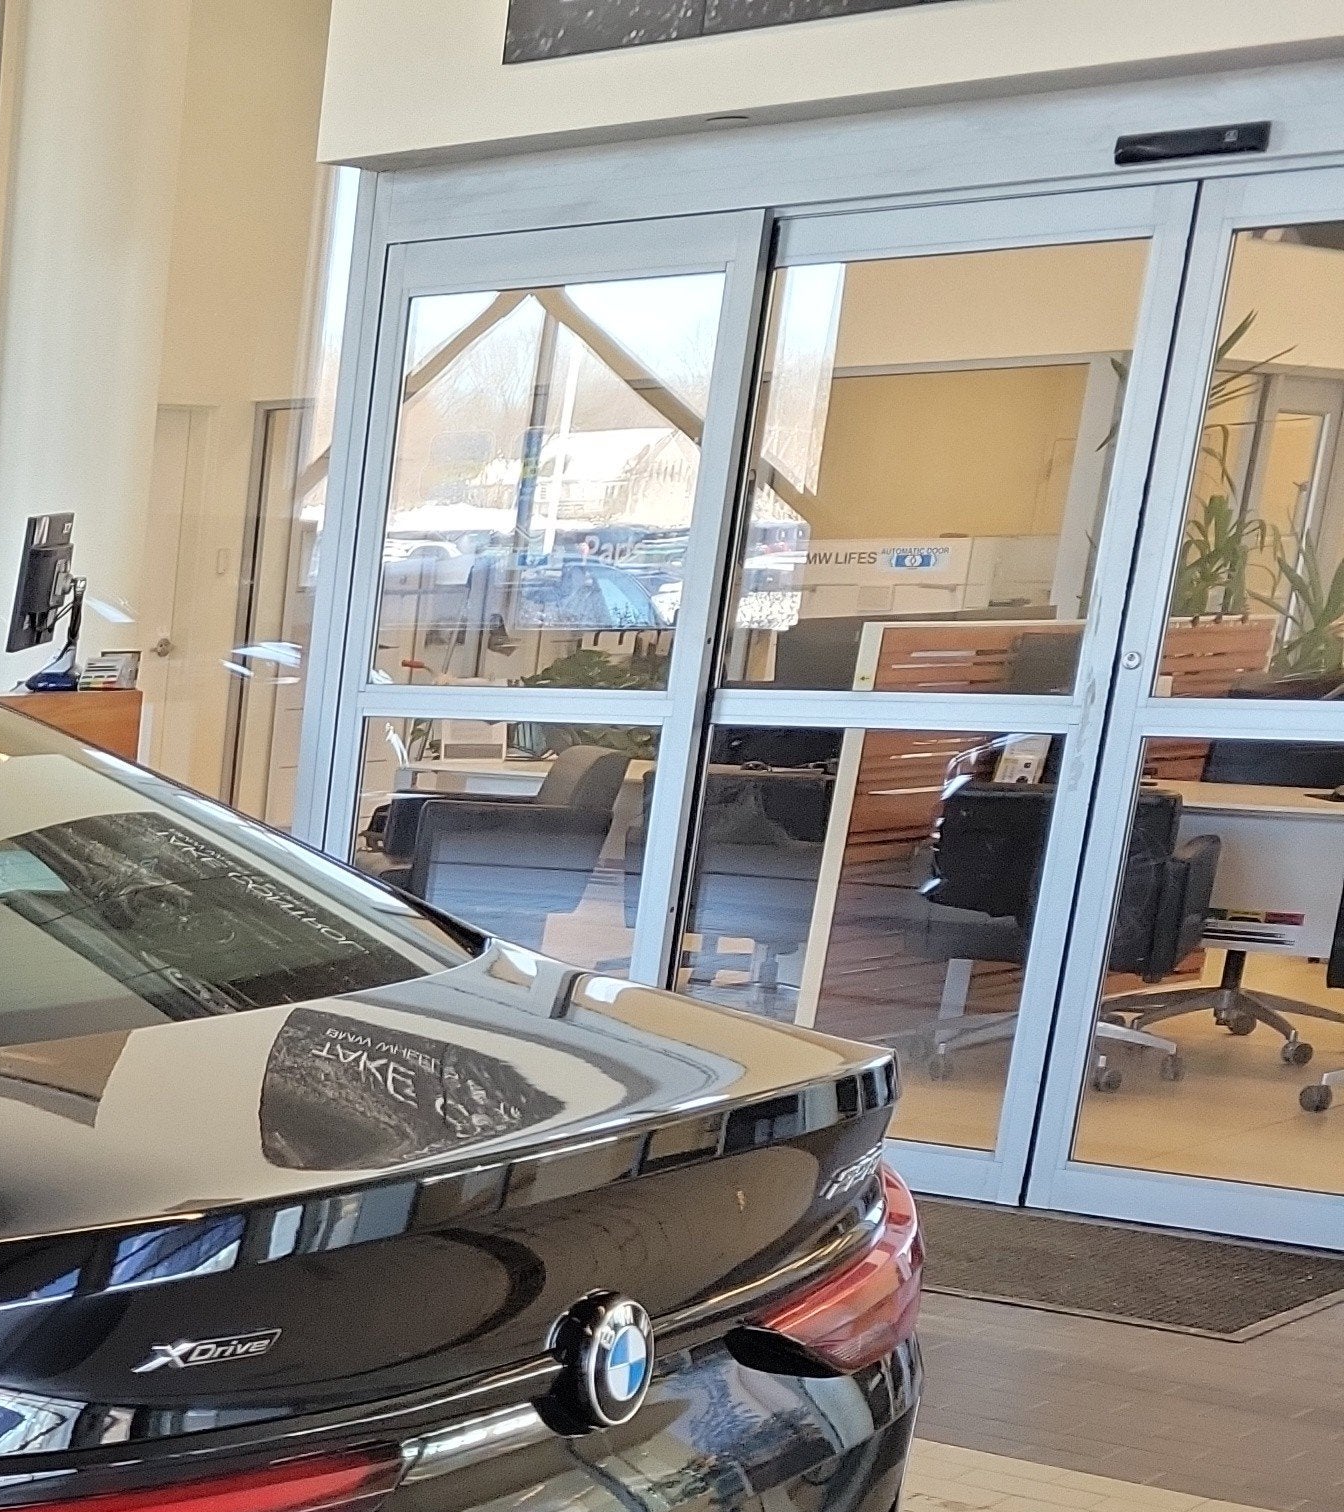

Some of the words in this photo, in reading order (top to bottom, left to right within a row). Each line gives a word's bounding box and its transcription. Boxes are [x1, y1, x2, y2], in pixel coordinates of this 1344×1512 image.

[881, 547, 925, 555] AUTOMATIC
[927, 547, 950, 555] DOOR
[806, 552, 833, 565] MW
